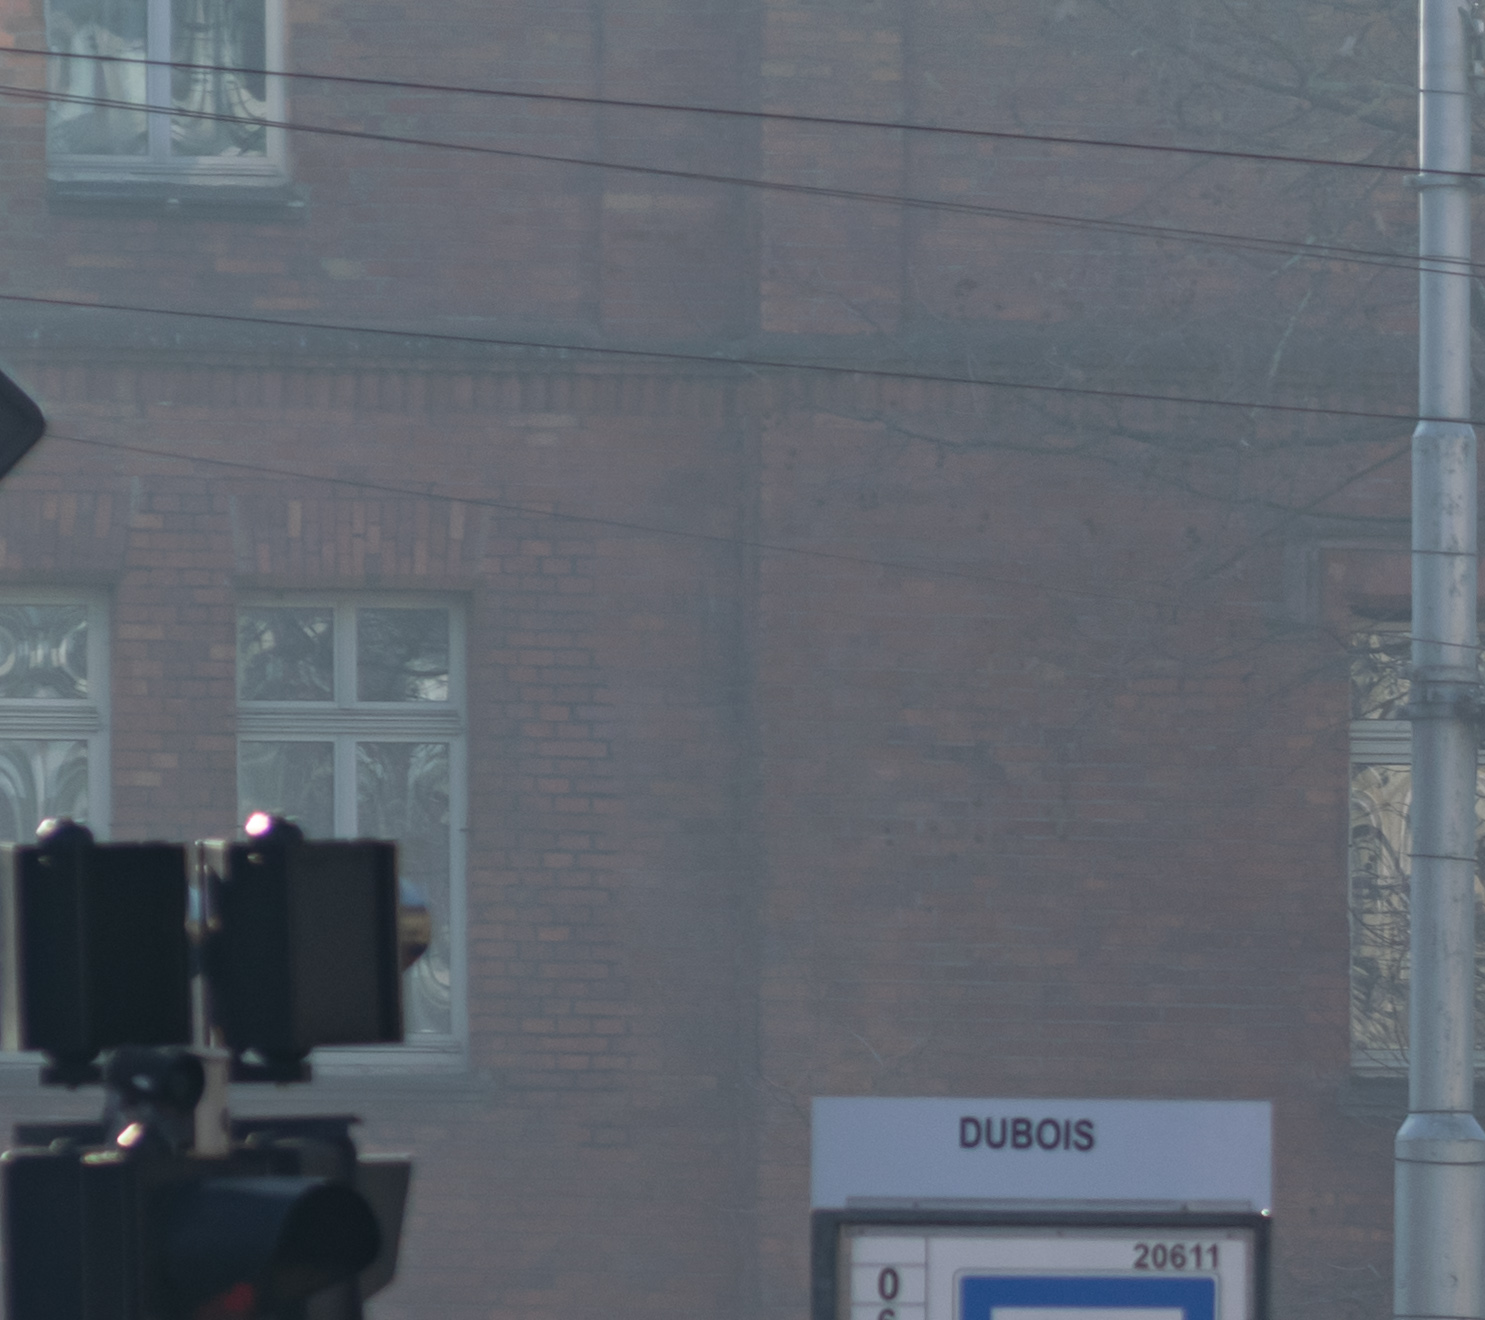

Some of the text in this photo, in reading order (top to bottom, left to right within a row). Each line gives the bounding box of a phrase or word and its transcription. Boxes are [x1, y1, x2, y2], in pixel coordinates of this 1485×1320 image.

[957, 1116, 1095, 1151] DUBOIS
[1133, 1243, 1219, 1271] 20611
[878, 1267, 900, 1301] 0
